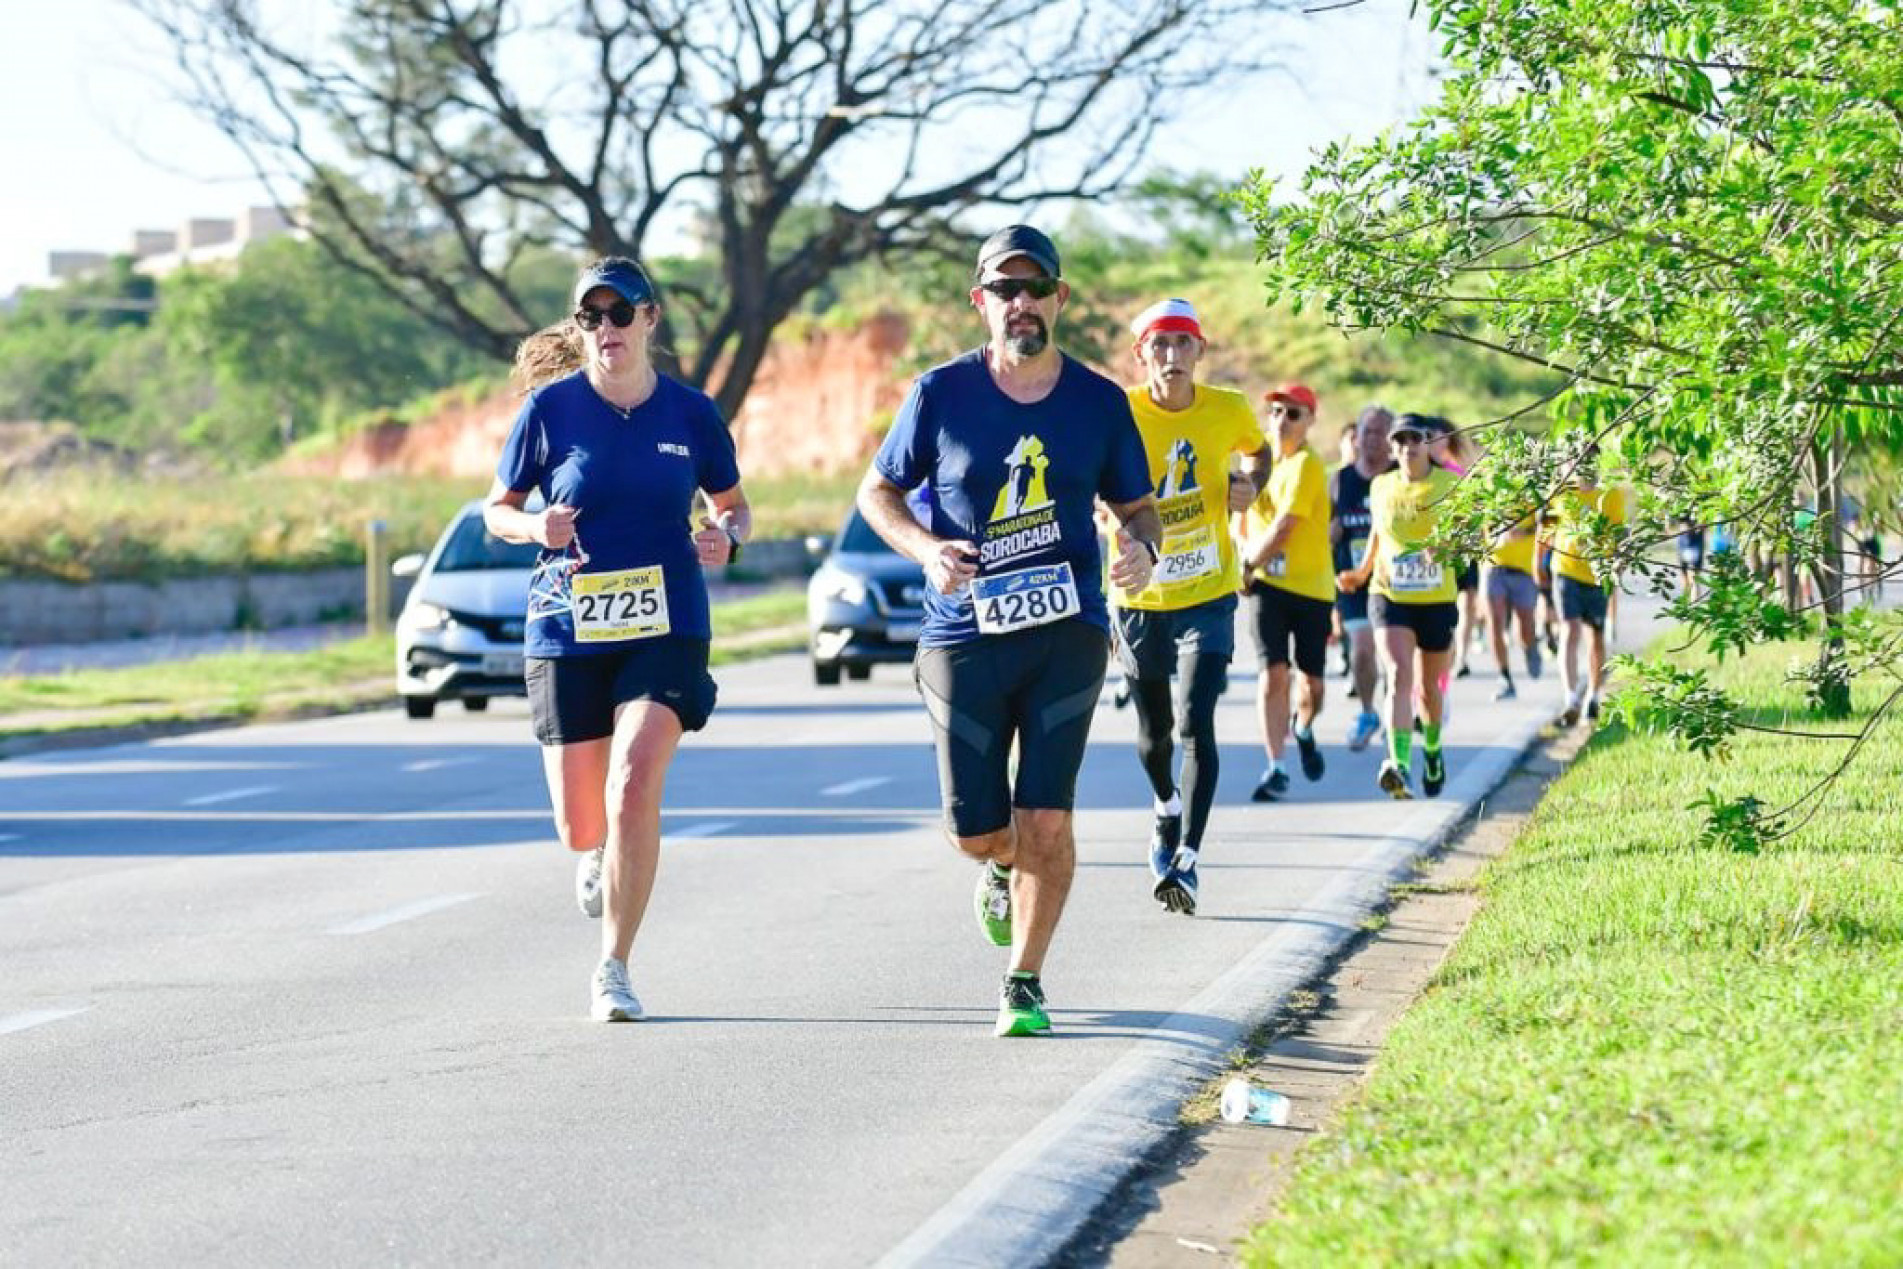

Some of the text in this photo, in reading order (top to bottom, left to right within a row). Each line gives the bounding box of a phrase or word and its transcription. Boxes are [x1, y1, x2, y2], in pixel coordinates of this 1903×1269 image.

[980, 521, 1062, 564] SOROCABA
[1164, 549, 1205, 575] 2956
[577, 588, 659, 622] 2725
[984, 586, 1068, 626] 4280
